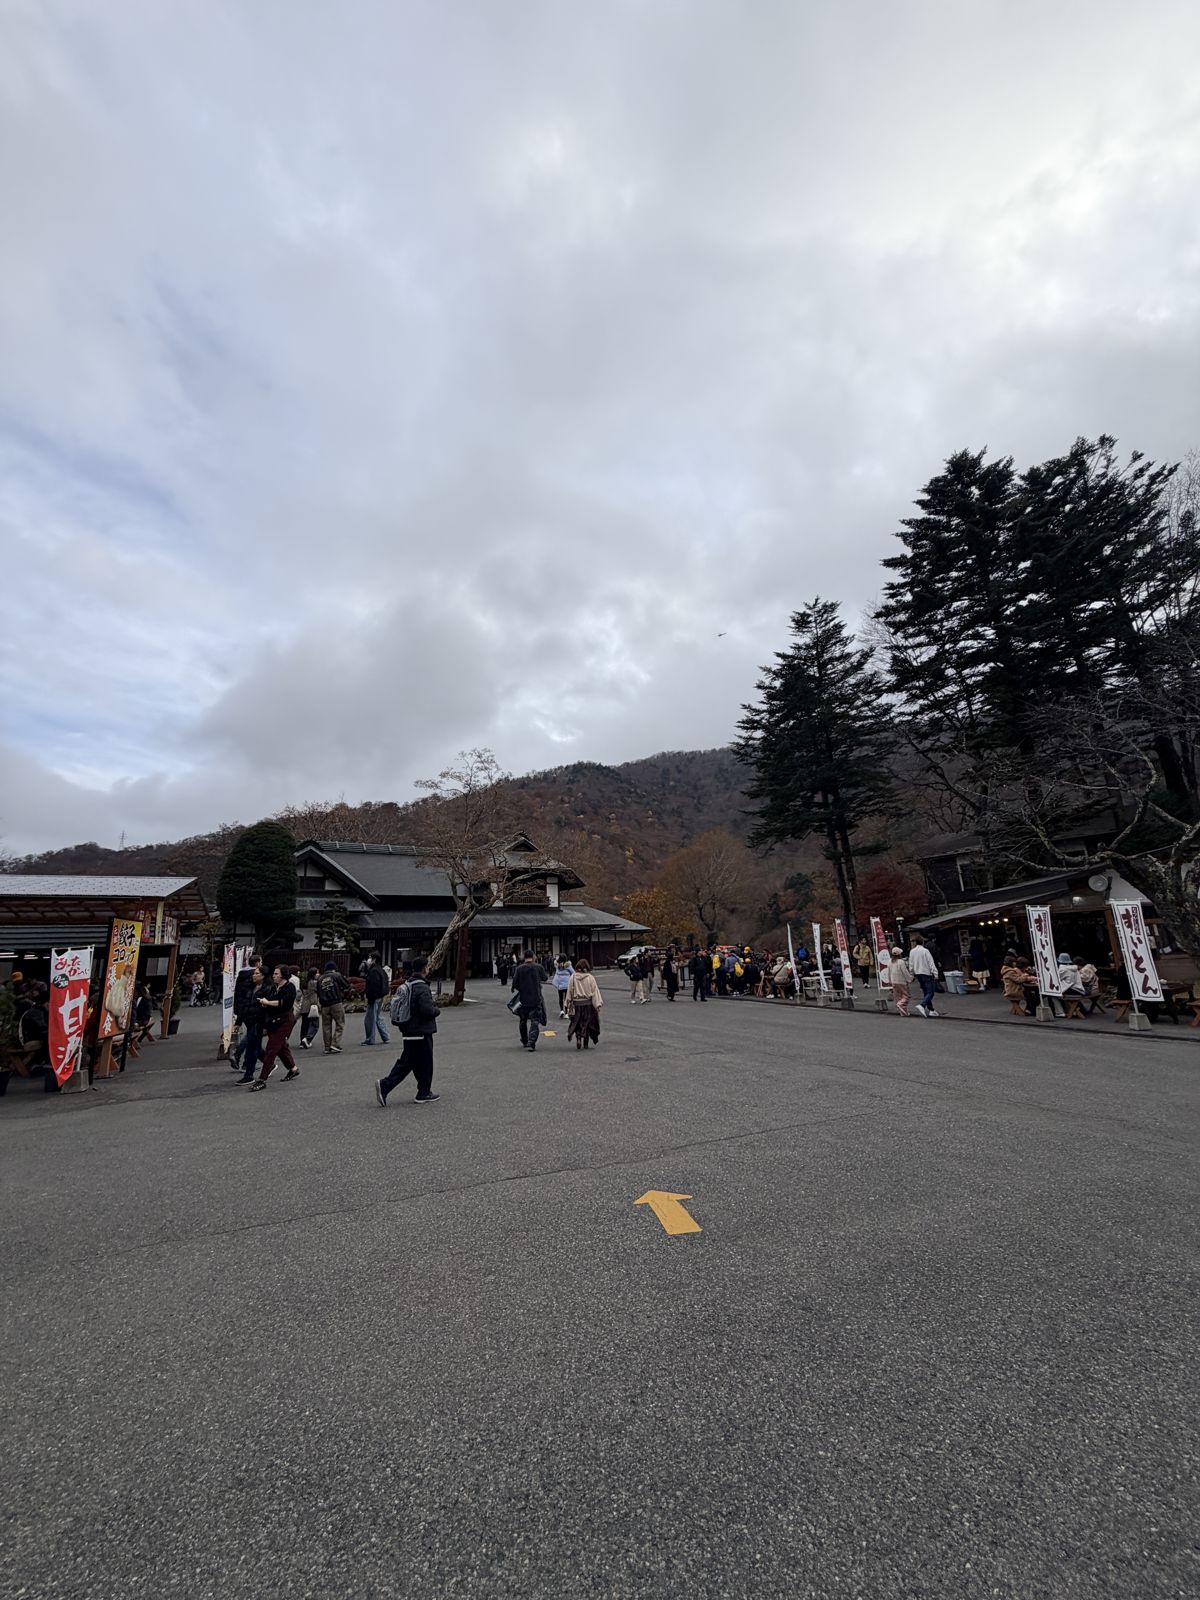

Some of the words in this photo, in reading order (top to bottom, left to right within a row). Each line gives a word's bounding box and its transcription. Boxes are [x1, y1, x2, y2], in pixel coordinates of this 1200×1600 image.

[1034, 913, 1059, 991] すいとん
[1121, 908, 1158, 995] すいとん
